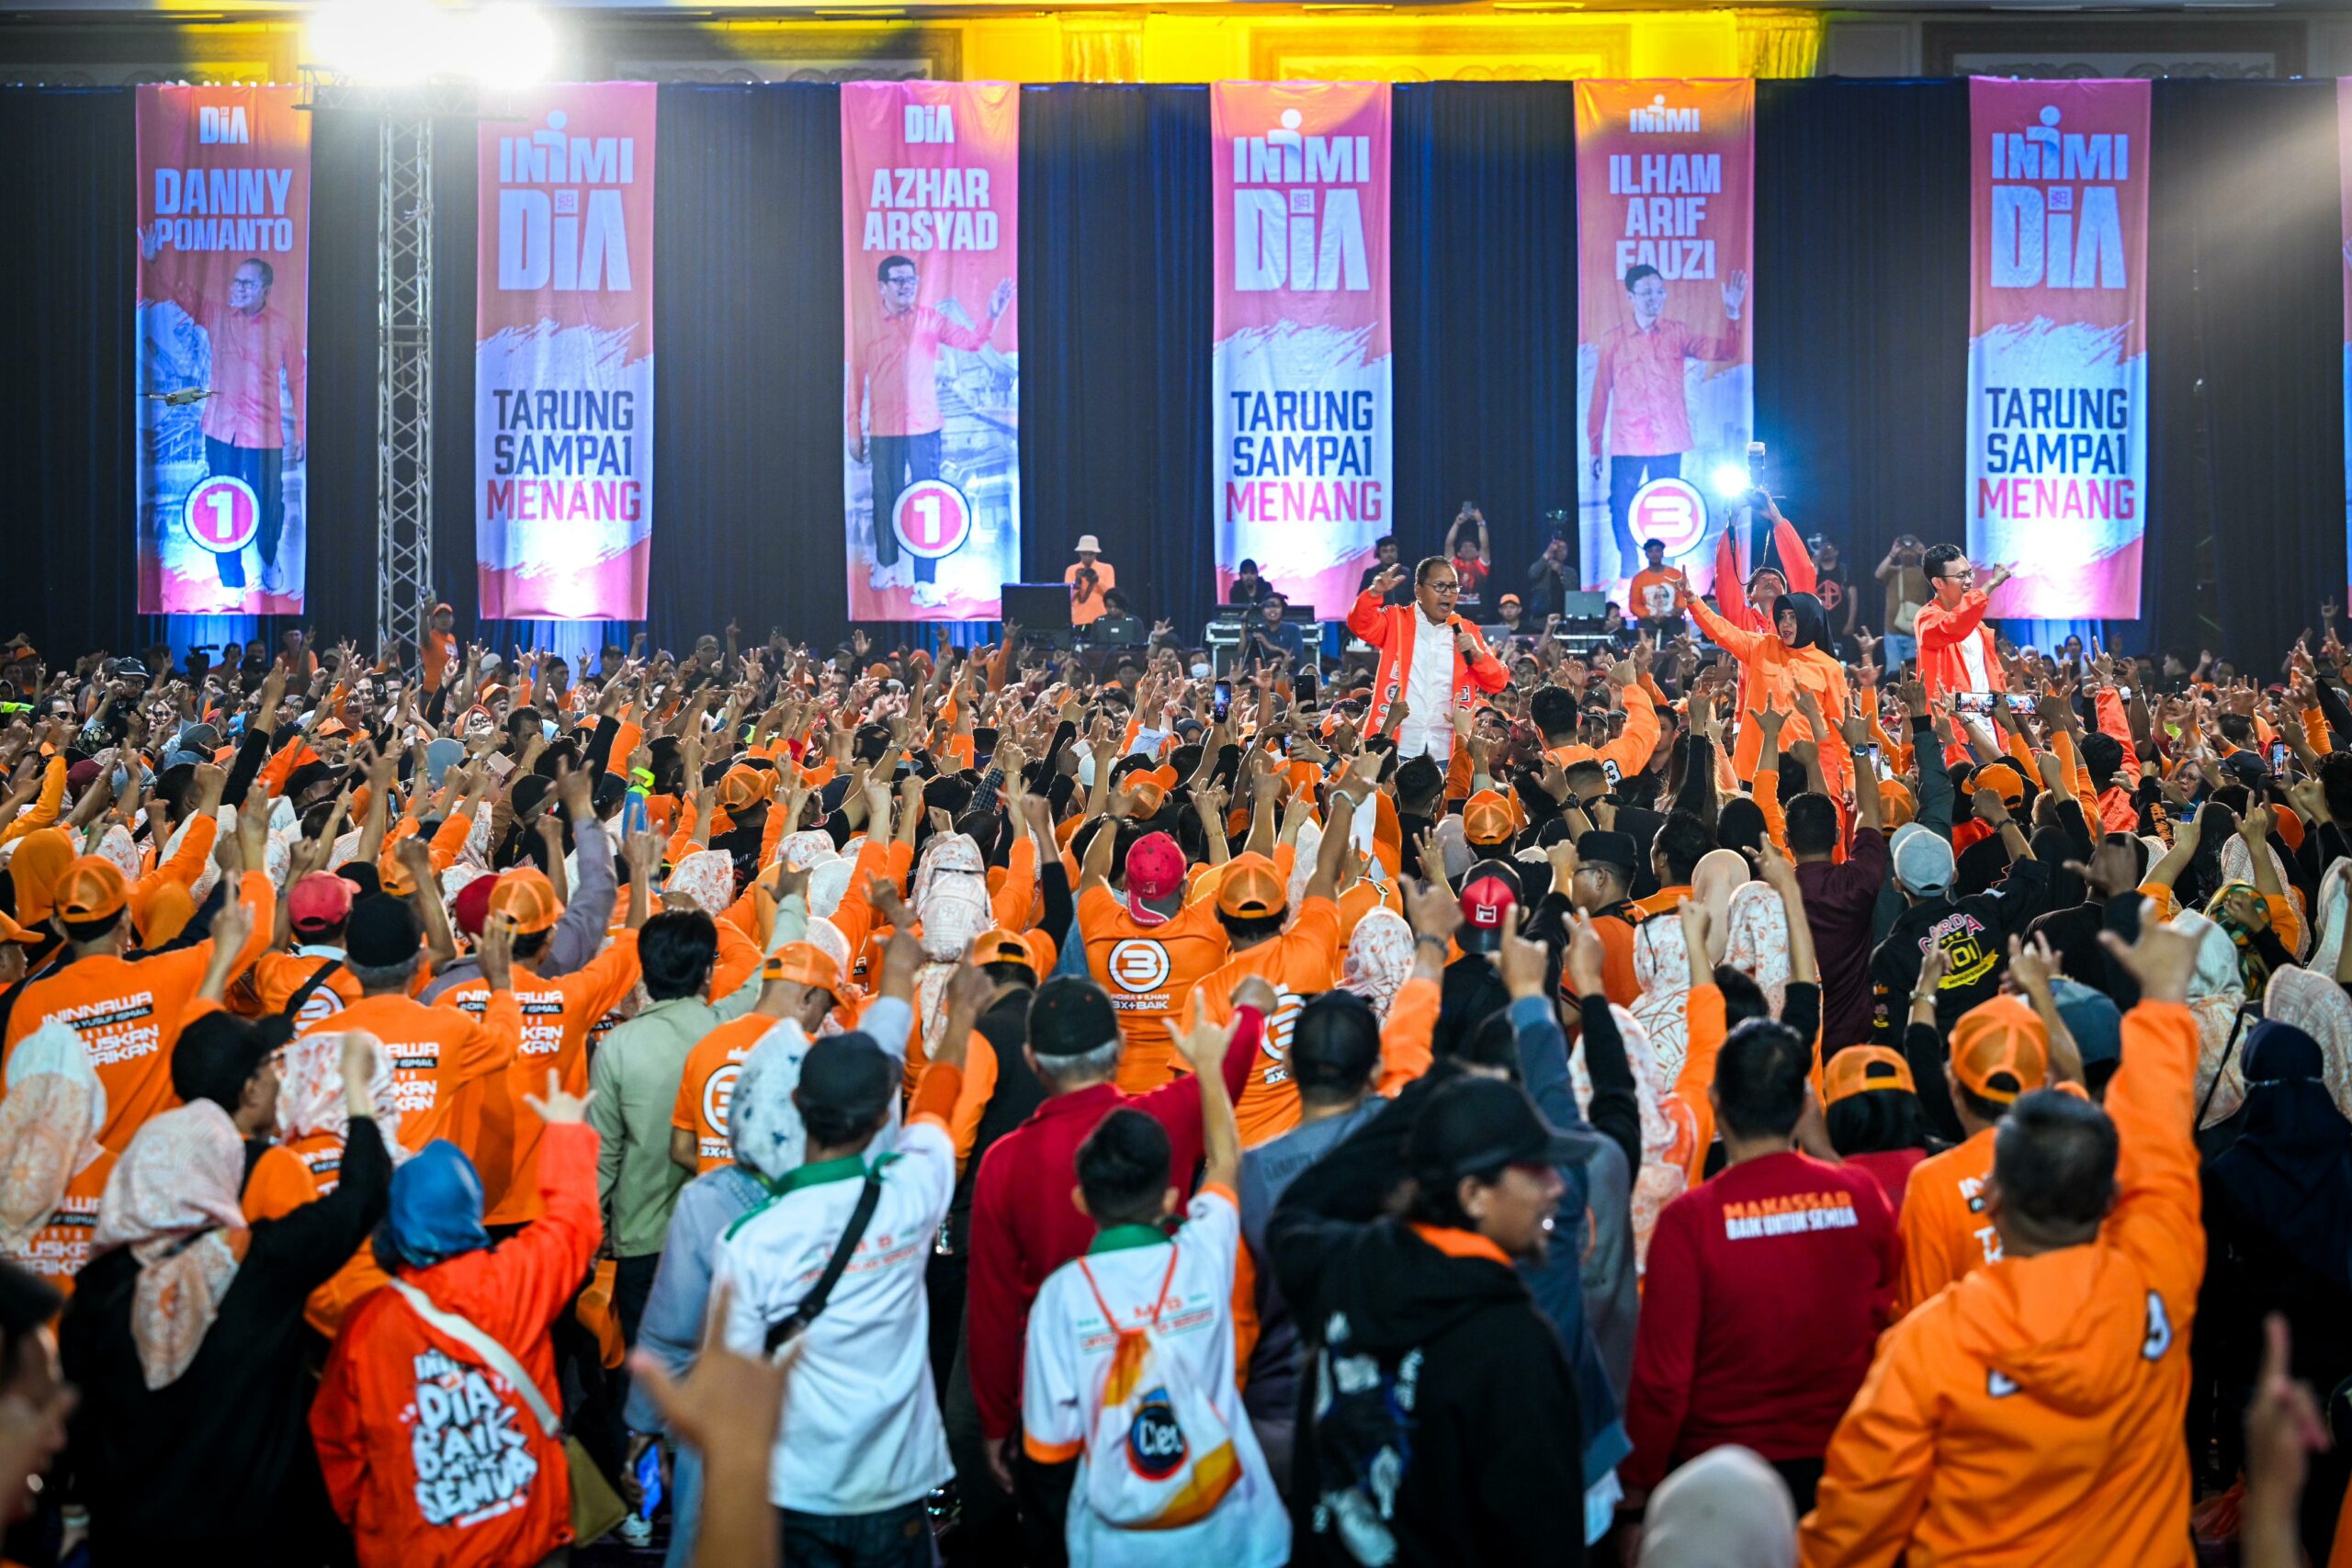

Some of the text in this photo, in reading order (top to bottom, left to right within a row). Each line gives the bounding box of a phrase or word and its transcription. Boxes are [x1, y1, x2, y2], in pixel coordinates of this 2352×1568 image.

[154, 168, 293, 215] DANNY
[870, 168, 989, 209] AZHAR
[1609, 153, 1722, 195] ILHAM
[155, 218, 293, 252] POMANTO
[863, 210, 999, 252] ARSYAD
[1624, 197, 1707, 237] ARIF
[1615, 239, 1716, 280] FAUZI
[492, 390, 634, 432] TARUNG
[1231, 390, 1374, 432] TARUNG
[1984, 387, 2128, 430] TARUNG
[494, 435, 633, 477] SAMPAI
[1233, 435, 1374, 478] SAMPAI
[1987, 433, 2127, 475] SAMPAI
[209, 491, 232, 538] 1
[486, 479, 641, 523] MENANG
[1226, 480, 1382, 523] MENANG
[1644, 495, 1693, 538] 3
[1977, 478, 2135, 520] MENANG
[914, 495, 943, 546] 1
[1122, 949, 1158, 978] 3
[1723, 1190, 1853, 1219] MAKASSAR
